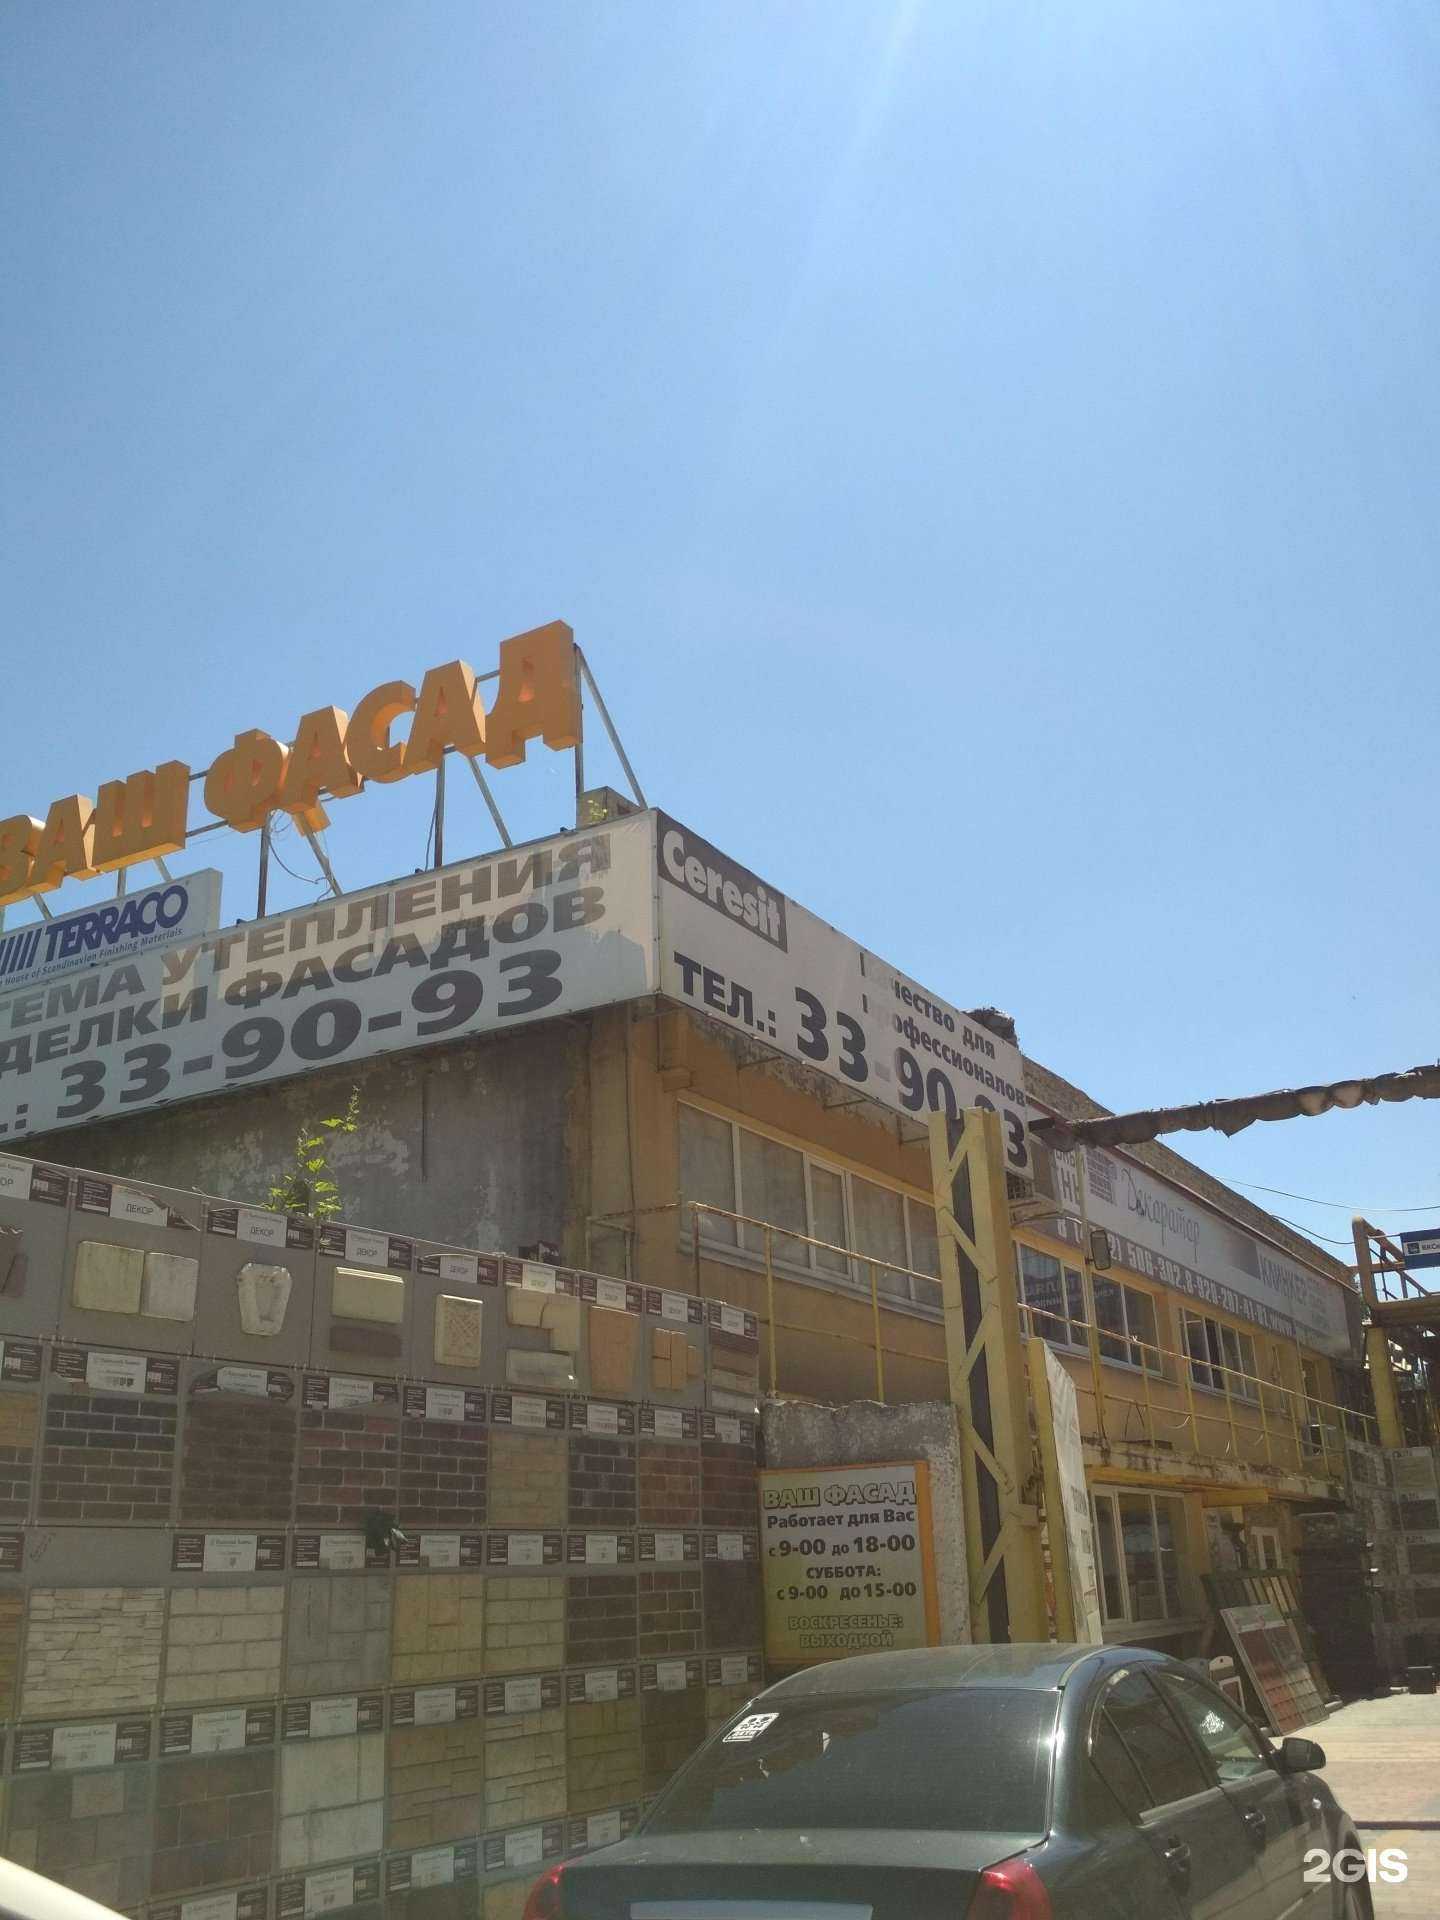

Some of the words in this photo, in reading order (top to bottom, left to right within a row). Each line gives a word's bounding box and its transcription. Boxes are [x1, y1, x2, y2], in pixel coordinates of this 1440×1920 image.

[204, 619, 580, 836] ФАСАД
[662, 830, 781, 941] Ceresit
[0, 964, 146, 1028] ЕМА
[160, 834, 611, 986] УТЕПЛЕНИЯ
[45, 885, 189, 963] TERRACO
[224, 887, 606, 1009] ФАСАДОВ
[674, 951, 777, 1039] ТЕЛ.:
[56, 949, 563, 1119] 33-90-93
[963, 1025, 996, 1060] для
[125, 1202, 154, 1216] ДЕКОР
[763, 1487, 821, 1509] ВАШ
[824, 1481, 918, 1505] ФАСАД
[767, 1513, 844, 1529] Работает
[848, 1512, 879, 1527] для
[883, 1509, 915, 1523] Вас
[769, 1547, 776, 1557] с
[779, 1539, 826, 1557] 9-00
[832, 1544, 850, 1556] до
[854, 1534, 916, 1554] 18-00
[806, 1565, 881, 1579] СУББОТА:
[777, 1588, 785, 1600] с
[788, 1585, 828, 1600] 9-00
[840, 1586, 861, 1601] до
[864, 1582, 917, 1598] 15-00
[800, 1630, 894, 1648] ВЫХОДНОЙ
